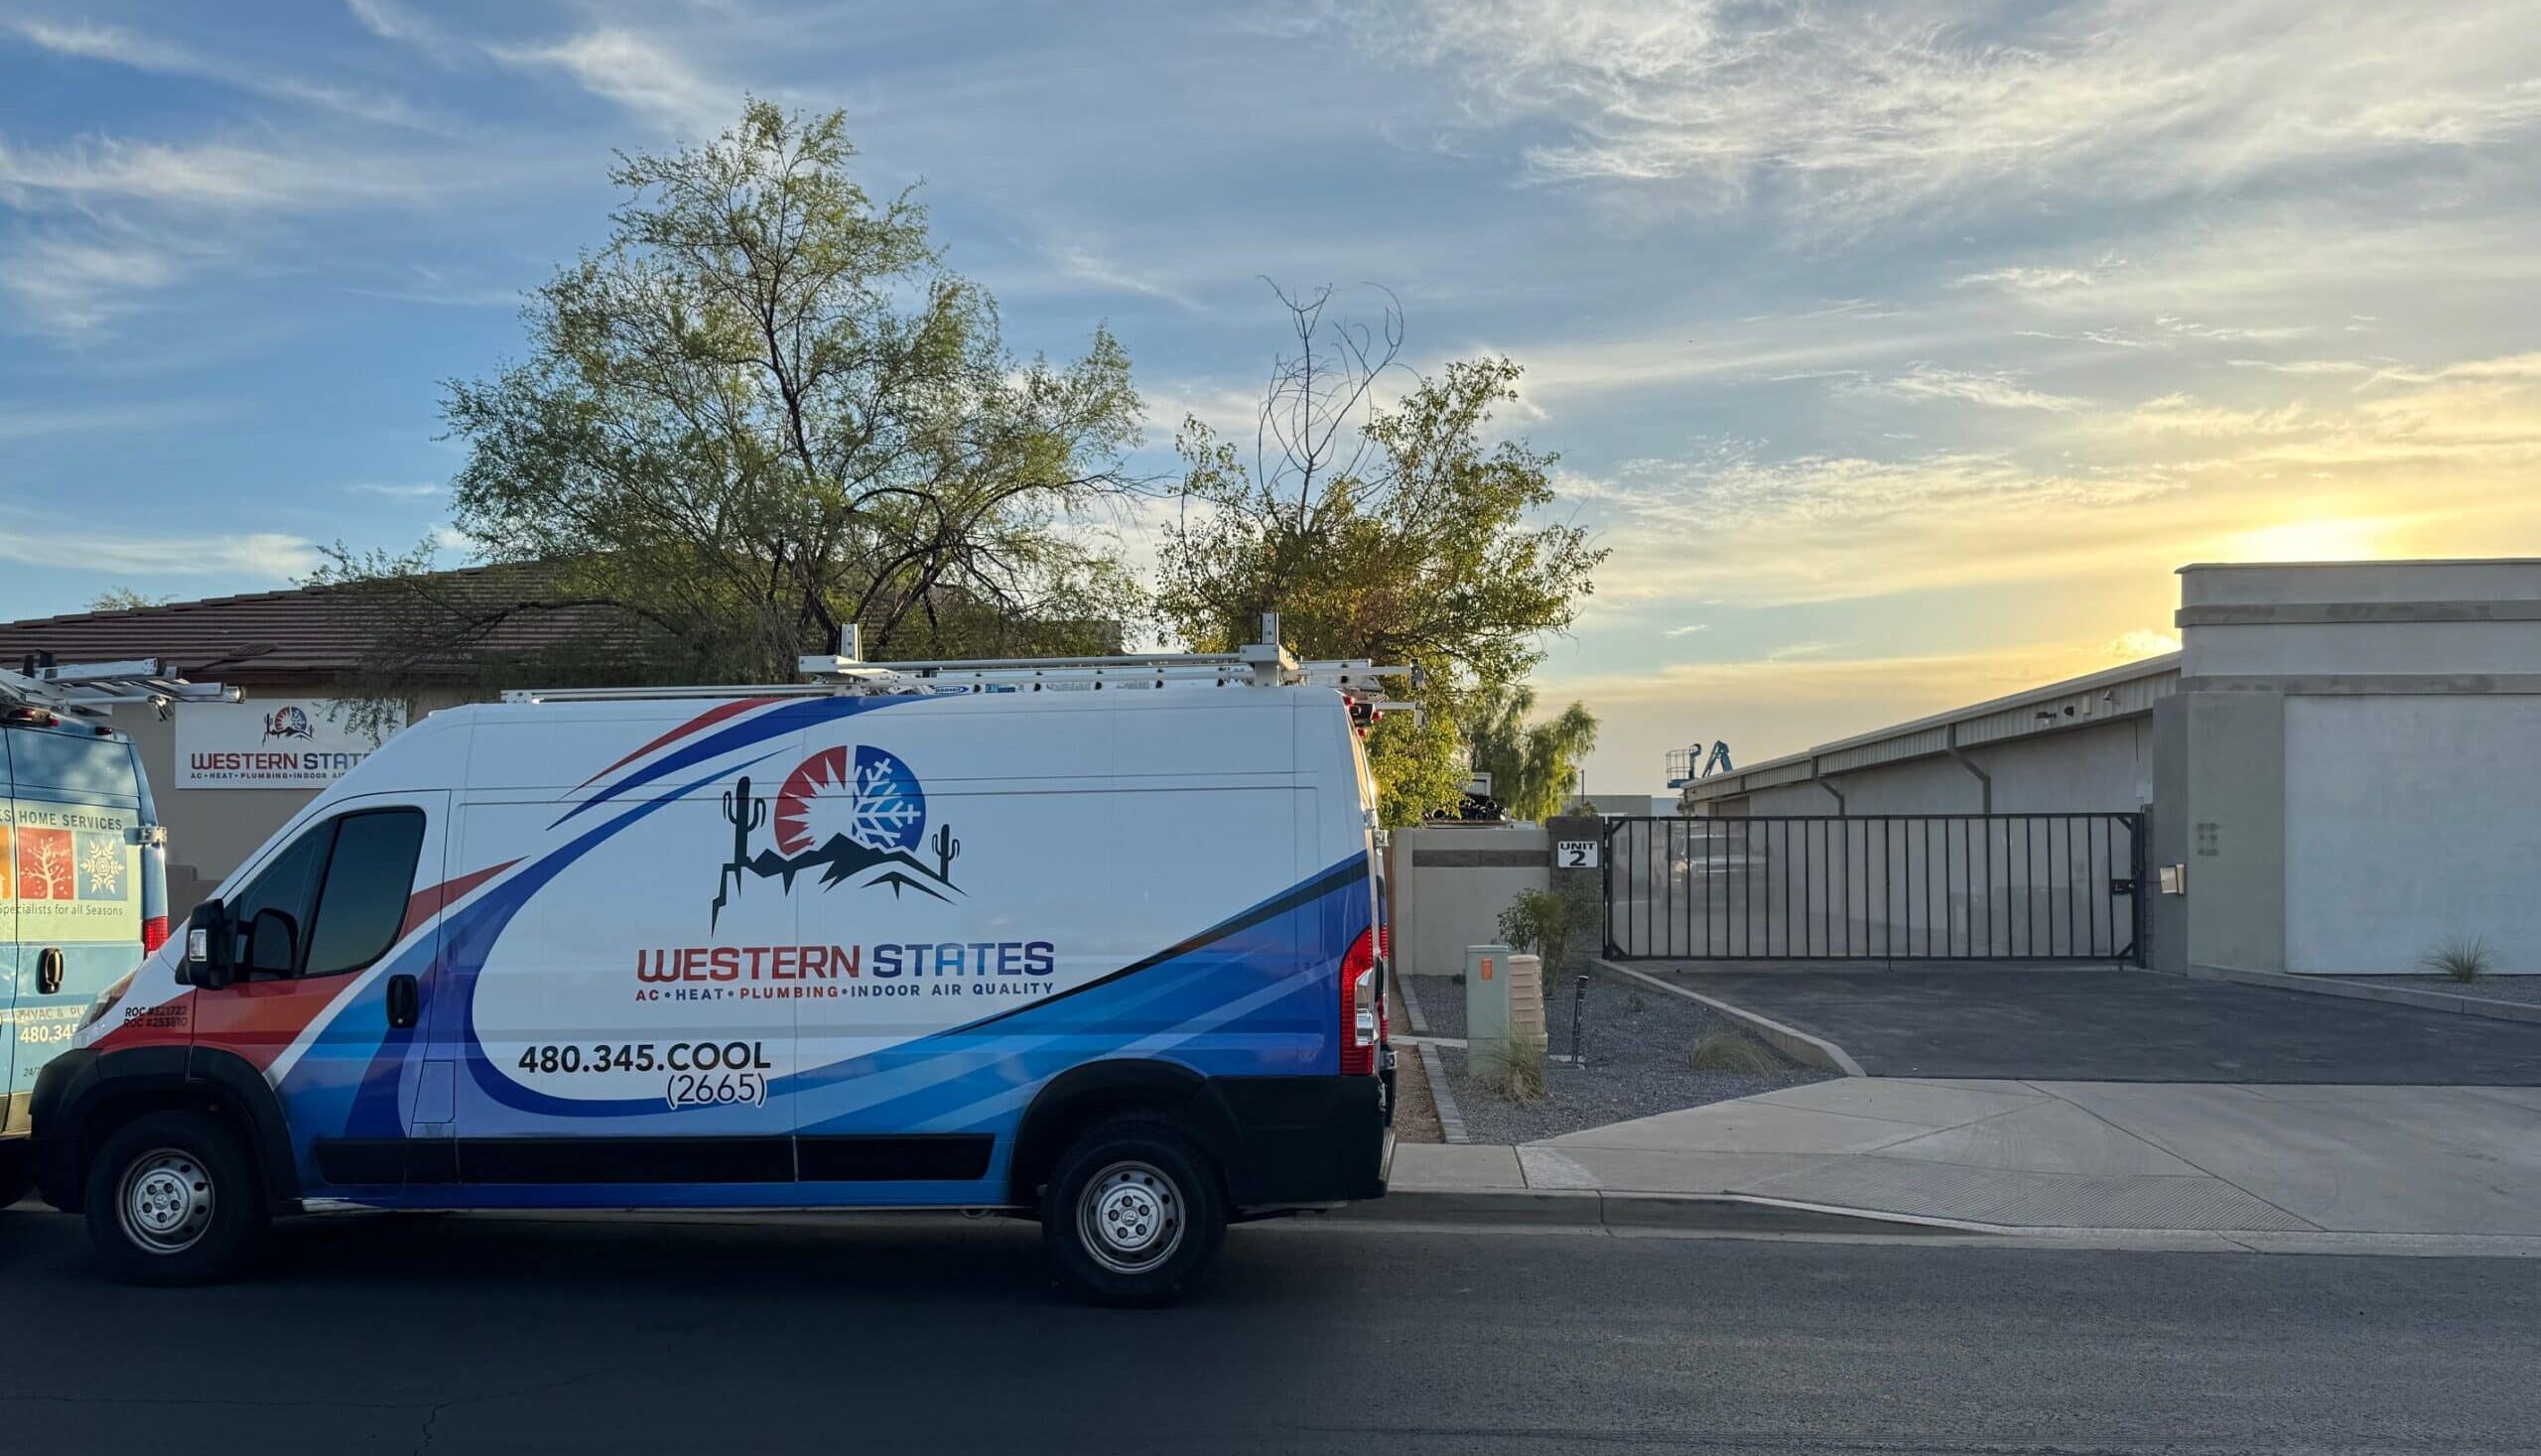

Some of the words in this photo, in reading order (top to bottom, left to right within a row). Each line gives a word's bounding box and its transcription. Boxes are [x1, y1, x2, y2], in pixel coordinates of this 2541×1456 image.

[191, 752, 298, 770] WESTERN
[303, 752, 371, 770] STAT
[19, 811, 57, 825] HOME
[63, 814, 123, 831] SERVICES
[1560, 842, 1596, 851] UNIT
[1569, 851, 1586, 866] 2
[55, 904, 69, 915] for
[71, 905, 83, 916] all
[86, 906, 123, 916] Seasons
[636, 945, 861, 983] WESTERN
[872, 941, 1055, 979] STATES
[635, 990, 659, 1001] AC
[675, 988, 724, 1000] HEAT
[739, 986, 839, 999] PLUMBING
[851, 985, 921, 997] INDOOR
[931, 984, 962, 995] AIR
[973, 983, 1053, 995] QUALITY
[125, 1006, 146, 1017] ROC
[123, 1017, 144, 1028] ROC
[518, 1041, 771, 1073] 480.345.COOL
[666, 1073, 766, 1109] (2665)
